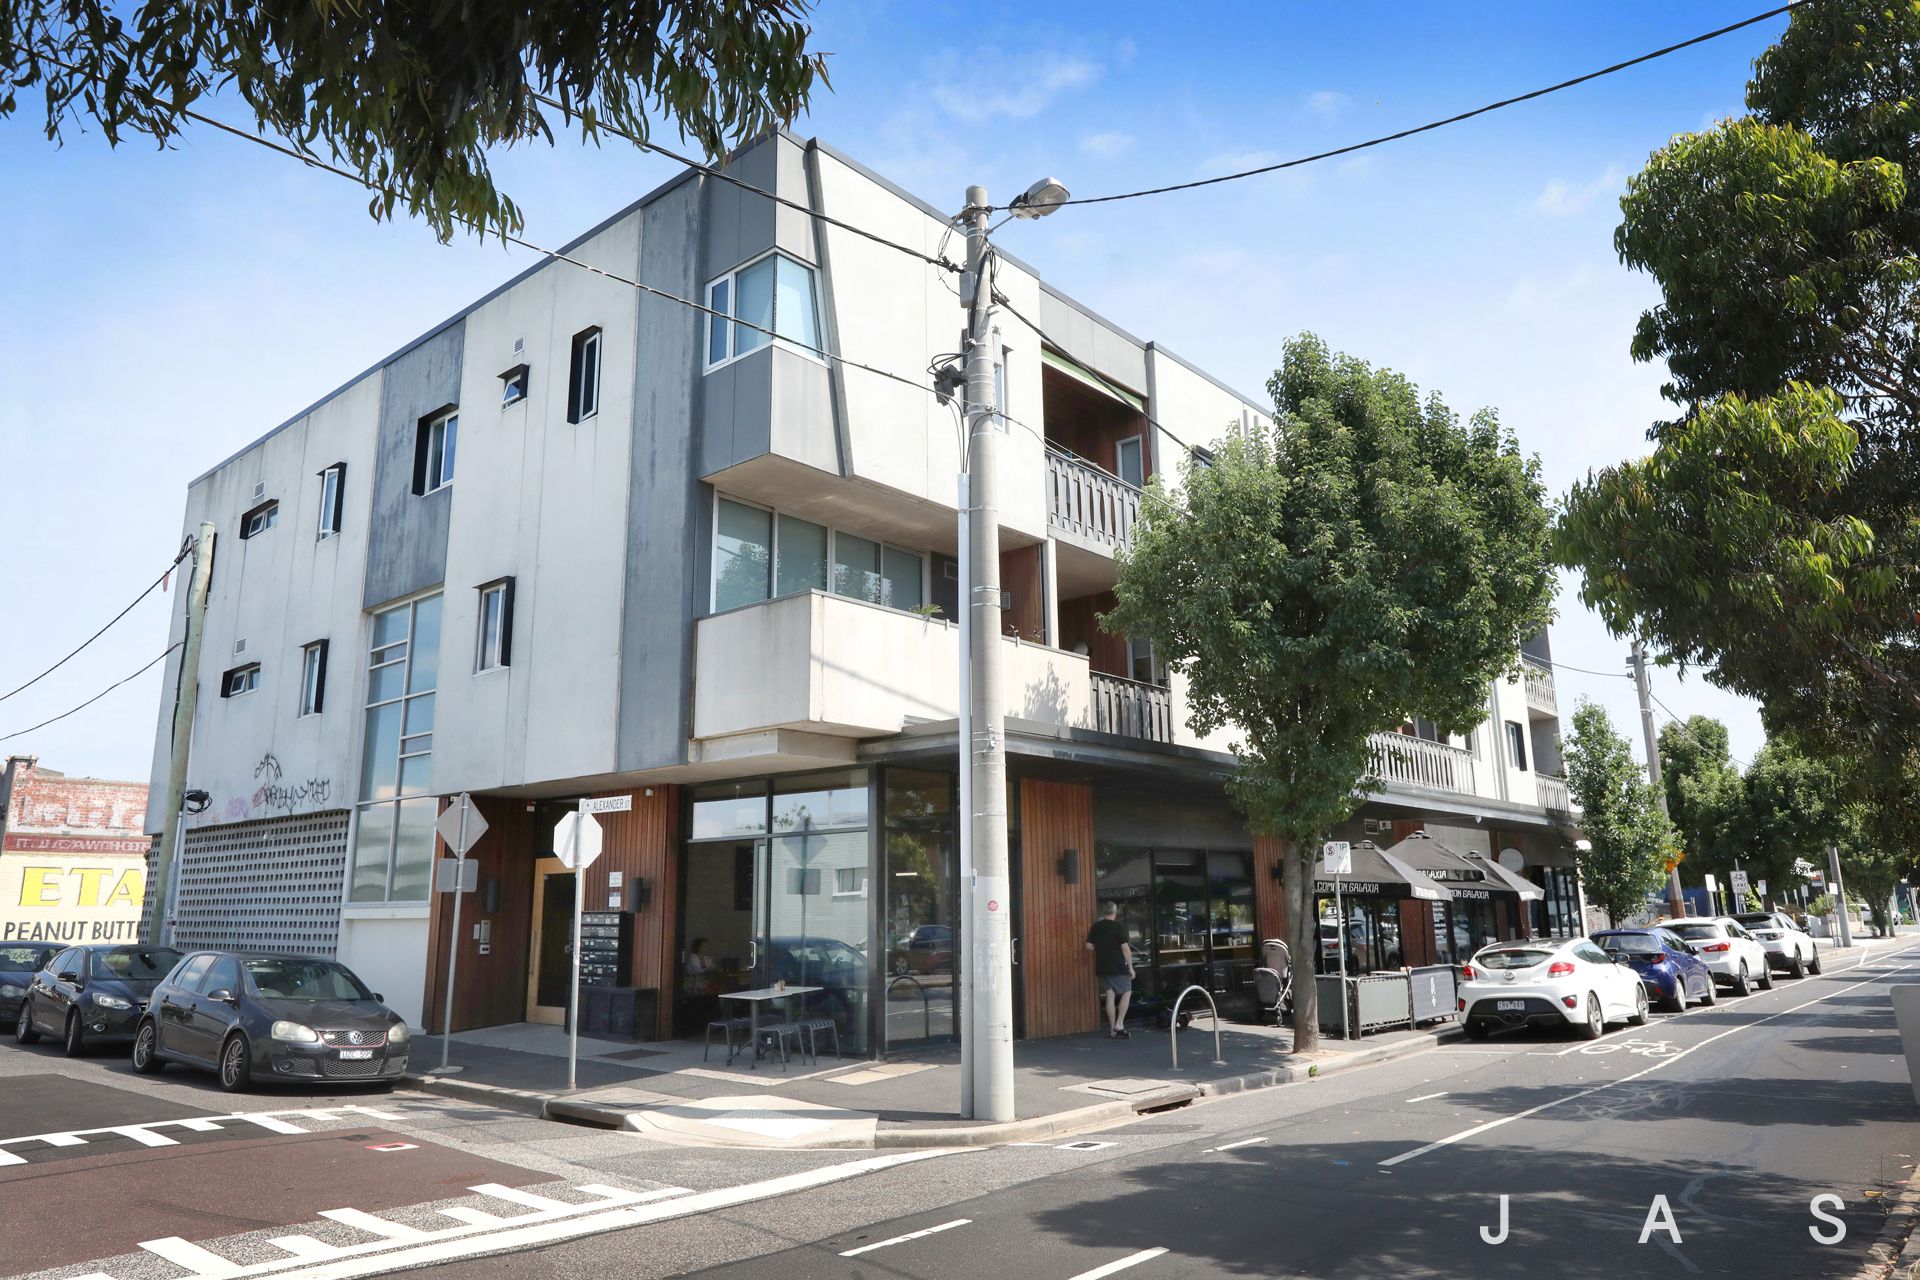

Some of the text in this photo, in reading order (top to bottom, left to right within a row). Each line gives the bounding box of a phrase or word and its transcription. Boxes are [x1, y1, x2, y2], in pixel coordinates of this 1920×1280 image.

[593, 799, 624, 811] ALEXANDER
[18, 866, 145, 907] ETA
[1348, 883, 1379, 893] GALAXIA
[1462, 889, 1490, 900] GALAXIA
[3, 921, 89, 941] PEANUT
